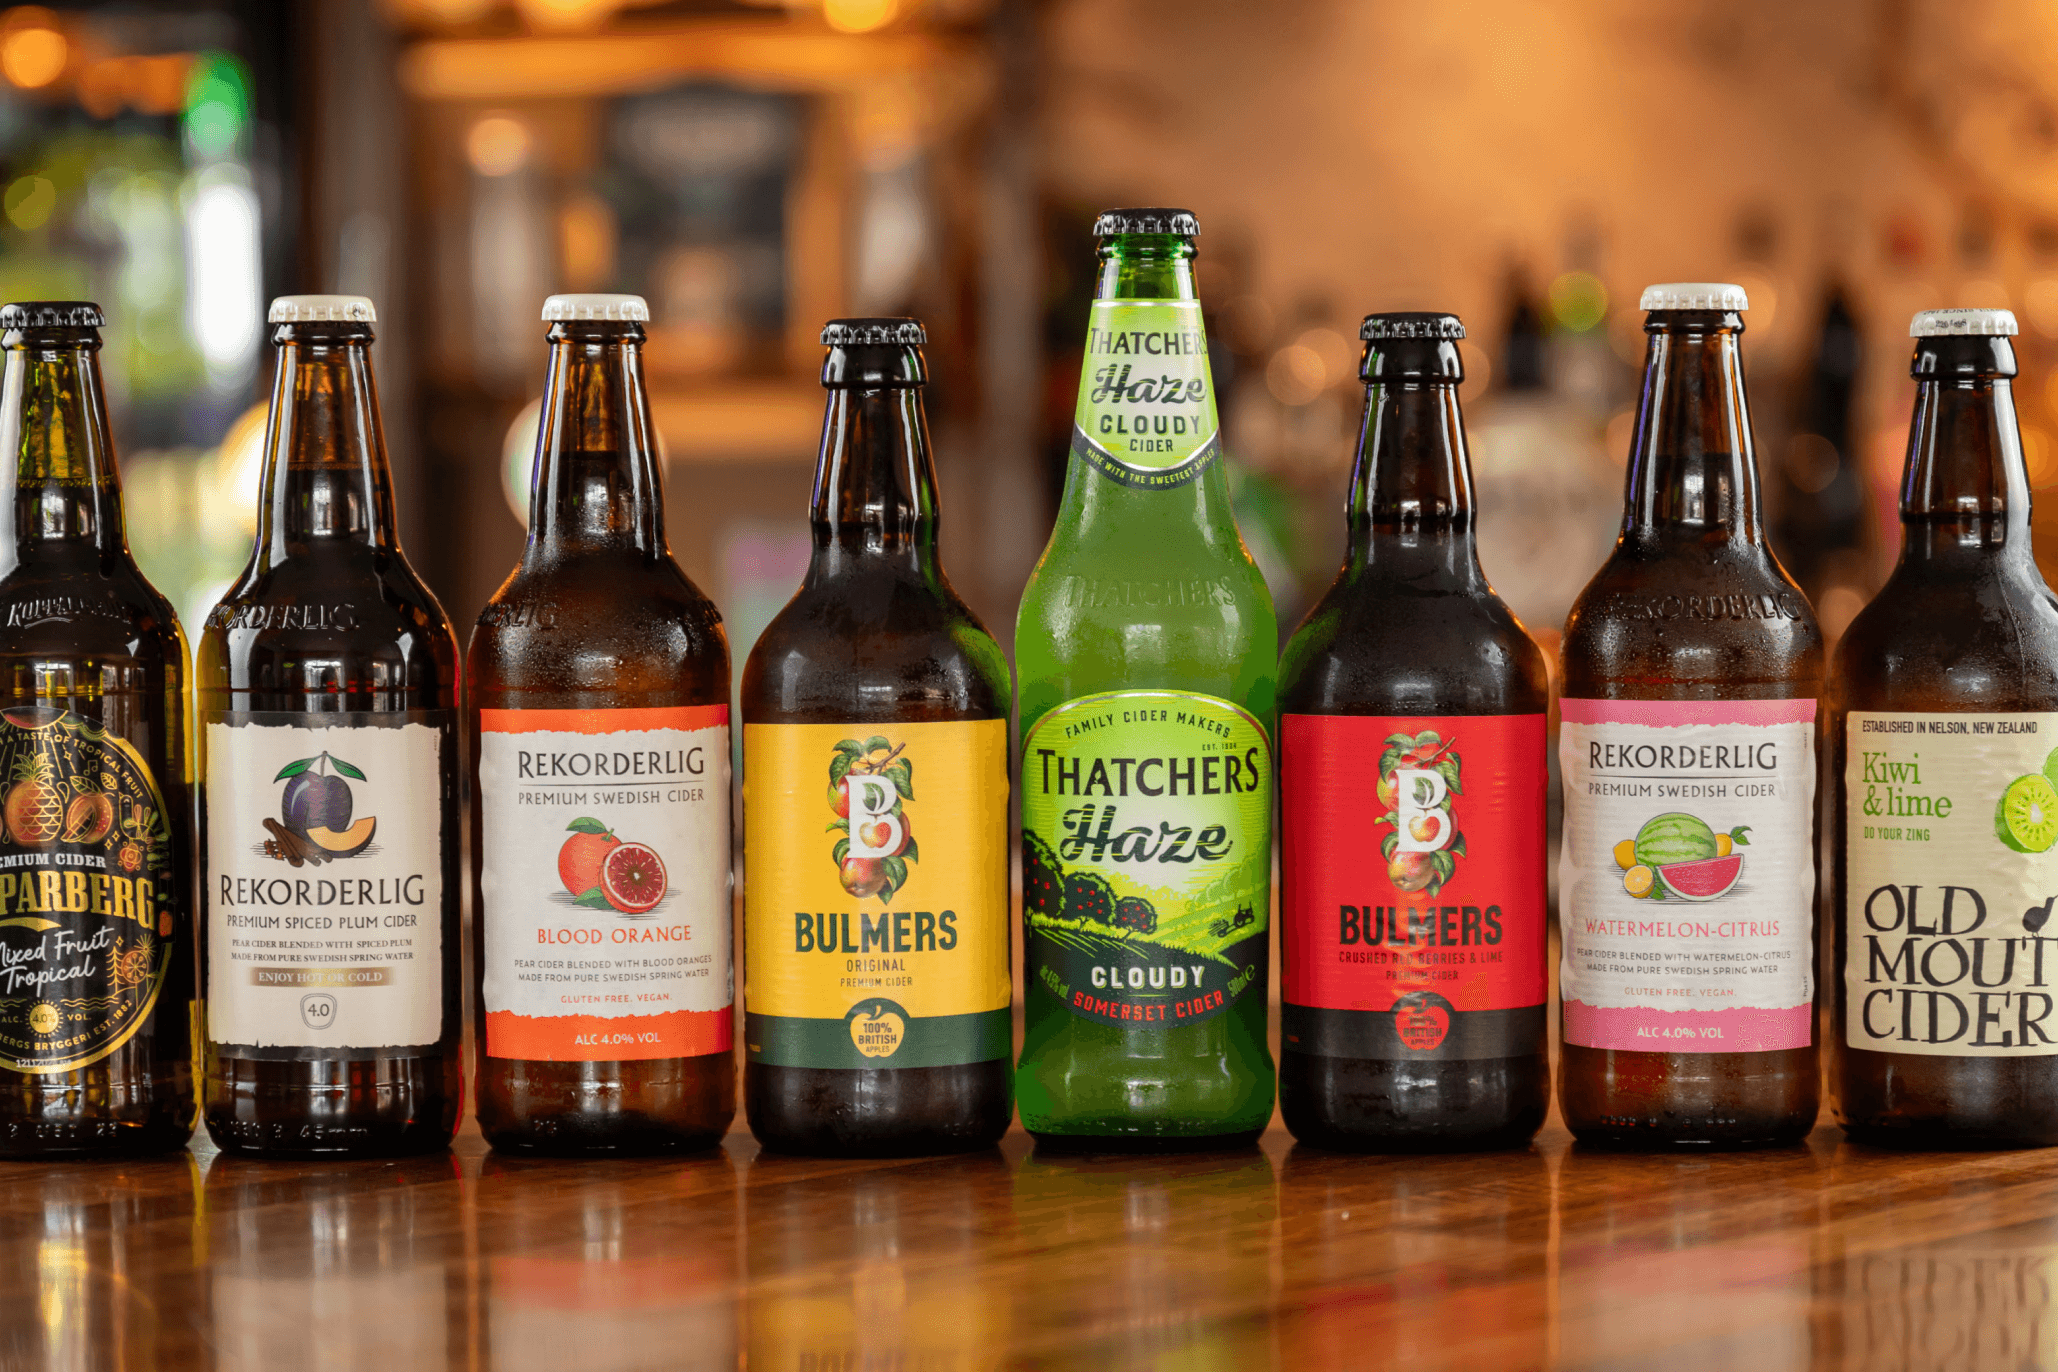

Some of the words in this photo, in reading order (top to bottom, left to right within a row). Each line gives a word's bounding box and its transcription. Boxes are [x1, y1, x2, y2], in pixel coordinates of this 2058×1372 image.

[1089, 328, 1208, 355] THATCHERS
[1091, 363, 1207, 404] Haze
[1099, 414, 1200, 434] CLOUDY
[1129, 439, 1173, 452] CIDER
[1104, 461, 1126, 479] WITH
[1129, 473, 1146, 484] THE
[1150, 467, 1194, 485] SWEETEST
[1065, 713, 1115, 739] FAMILY
[1123, 710, 1167, 723] CIDER
[1176, 711, 1231, 739] MAKERS
[1862, 720, 1914, 733] ESTABLISHED
[1916, 722, 1926, 733] IN
[1929, 722, 1970, 734] NELSON,
[1973, 722, 1995, 733] NEW
[1997, 722, 2038, 733] ZEALAND
[518, 747, 704, 778] REKORDERLIG
[1590, 741, 1777, 770] REKORDERLIG
[18, 732, 51, 741] TASTE
[54, 734, 70, 744] OF
[73, 738, 121, 773] TROPICAL
[121, 771, 144, 799] FRUIT
[1037, 747, 1259, 797] THATCHERS
[1862, 752, 1922, 784] Kiwi
[518, 792, 587, 805] PREMIUM
[593, 790, 660, 804] SWEDISH
[667, 788, 704, 802] CIDER
[1588, 783, 1652, 797] PREMIUM
[1658, 784, 1727, 797] SWEDISH
[1734, 783, 1776, 797] CIDER
[1059, 803, 1234, 863] Haze
[1864, 826, 1875, 839] DO
[1878, 827, 1902, 840] YOUR
[1906, 828, 1930, 841] ZING
[0, 853, 50, 868] MIUM
[55, 853, 107, 868] CIDER
[220, 874, 425, 906] REKORDERLIG
[1864, 883, 1987, 937] OLD
[227, 914, 280, 929] PREMIUM
[285, 916, 333, 929] SPICED
[339, 916, 378, 928] PLUM
[384, 914, 418, 927] CIDER
[1339, 905, 1503, 946] BULMERS
[1585, 918, 1780, 938] WATERMELON-CITRUS
[537, 928, 603, 944] BLOOD
[611, 925, 692, 944] ORANGE
[794, 910, 958, 953] BULMERS
[54, 925, 115, 961] Fruit
[232, 939, 250, 948] PEAR
[251, 939, 277, 949] CIDER
[279, 940, 323, 949] BLENDED
[325, 940, 353, 949] WITH
[356, 939, 389, 949] SPICED
[390, 938, 412, 948] PLUM
[231, 952, 251, 961] MADE
[253, 953, 277, 962] FROM
[278, 953, 302, 962] PURE
[303, 954, 347, 962] SWEDISH
[349, 953, 383, 962] SPRING
[385, 951, 414, 961] WATER
[514, 959, 535, 968] PEAR
[538, 960, 564, 969] CIDER
[567, 960, 611, 969] BLENDED
[614, 959, 640, 968] WITH
[642, 958, 674, 967] BLOOD
[676, 954, 712, 966] ORANGES
[1339, 951, 1388, 964] CRUSHED
[1418, 952, 1465, 965] BERRIES
[1469, 952, 1477, 964] &
[1480, 951, 1503, 964] LIME
[1594, 950, 1617, 959] CIDER
[1619, 952, 1662, 961] BLENDED
[1665, 952, 1690, 961] WITH
[1694, 951, 1791, 962] WATERMELON-CITRUS
[1863, 935, 2058, 988] MOUT
[846, 959, 906, 973] ORIGINAL
[1587, 963, 1608, 973] MADE
[1609, 964, 1634, 974] FROM
[1637, 965, 1661, 974] PURE
[1664, 966, 1710, 975] SWEDISH
[1712, 966, 1748, 975] SPRING
[1750, 964, 1778, 974] WATER
[0, 954, 96, 998] Tropical
[258, 972, 295, 982] ENJOY
[297, 973, 325, 983] HOT
[327, 973, 345, 983] OR
[348, 972, 383, 982] COLD
[518, 973, 542, 982] MADE
[544, 973, 572, 983] FROM
[574, 973, 599, 982] PURE
[603, 972, 646, 982] SWEDISH
[649, 971, 682, 981] SPRING
[685, 968, 709, 978] WATER
[840, 978, 882, 987] PREMIUM
[885, 976, 913, 986] CIDER
[1091, 965, 1205, 989] CLOUDY
[1431, 970, 1459, 980] CIDER
[560, 995, 600, 1004] GLUTEN
[604, 994, 633, 1003] FREE.
[637, 993, 673, 1002] VEGAN.
[1624, 987, 1662, 996] GLUTEN
[1666, 988, 1695, 996] FREE.
[1699, 988, 1737, 997] VEGAN.
[307, 1003, 330, 1017] 4.0
[1073, 991, 1166, 1021] SOMERSET
[1175, 990, 1224, 1018] CIDER
[1863, 987, 2058, 1048] CIDER
[0, 1033, 30, 1050] ERGS
[34, 1032, 91, 1051] BRYGGERI
[93, 1018, 115, 1036] EST.
[113, 1000, 133, 1020] 1882
[863, 1022, 892, 1034] 100%
[1403, 1027, 1442, 1037] BRITISH
[1636, 1027, 1660, 1038] ALC
[1662, 1027, 1696, 1039] 4.0%
[1698, 1027, 1724, 1038] VOL
[575, 1034, 598, 1045] ALC
[600, 1033, 634, 1045] 4.0%
[637, 1032, 661, 1043] VOL
[858, 1034, 897, 1045] BRITISH
[865, 1045, 890, 1053] APPLES
